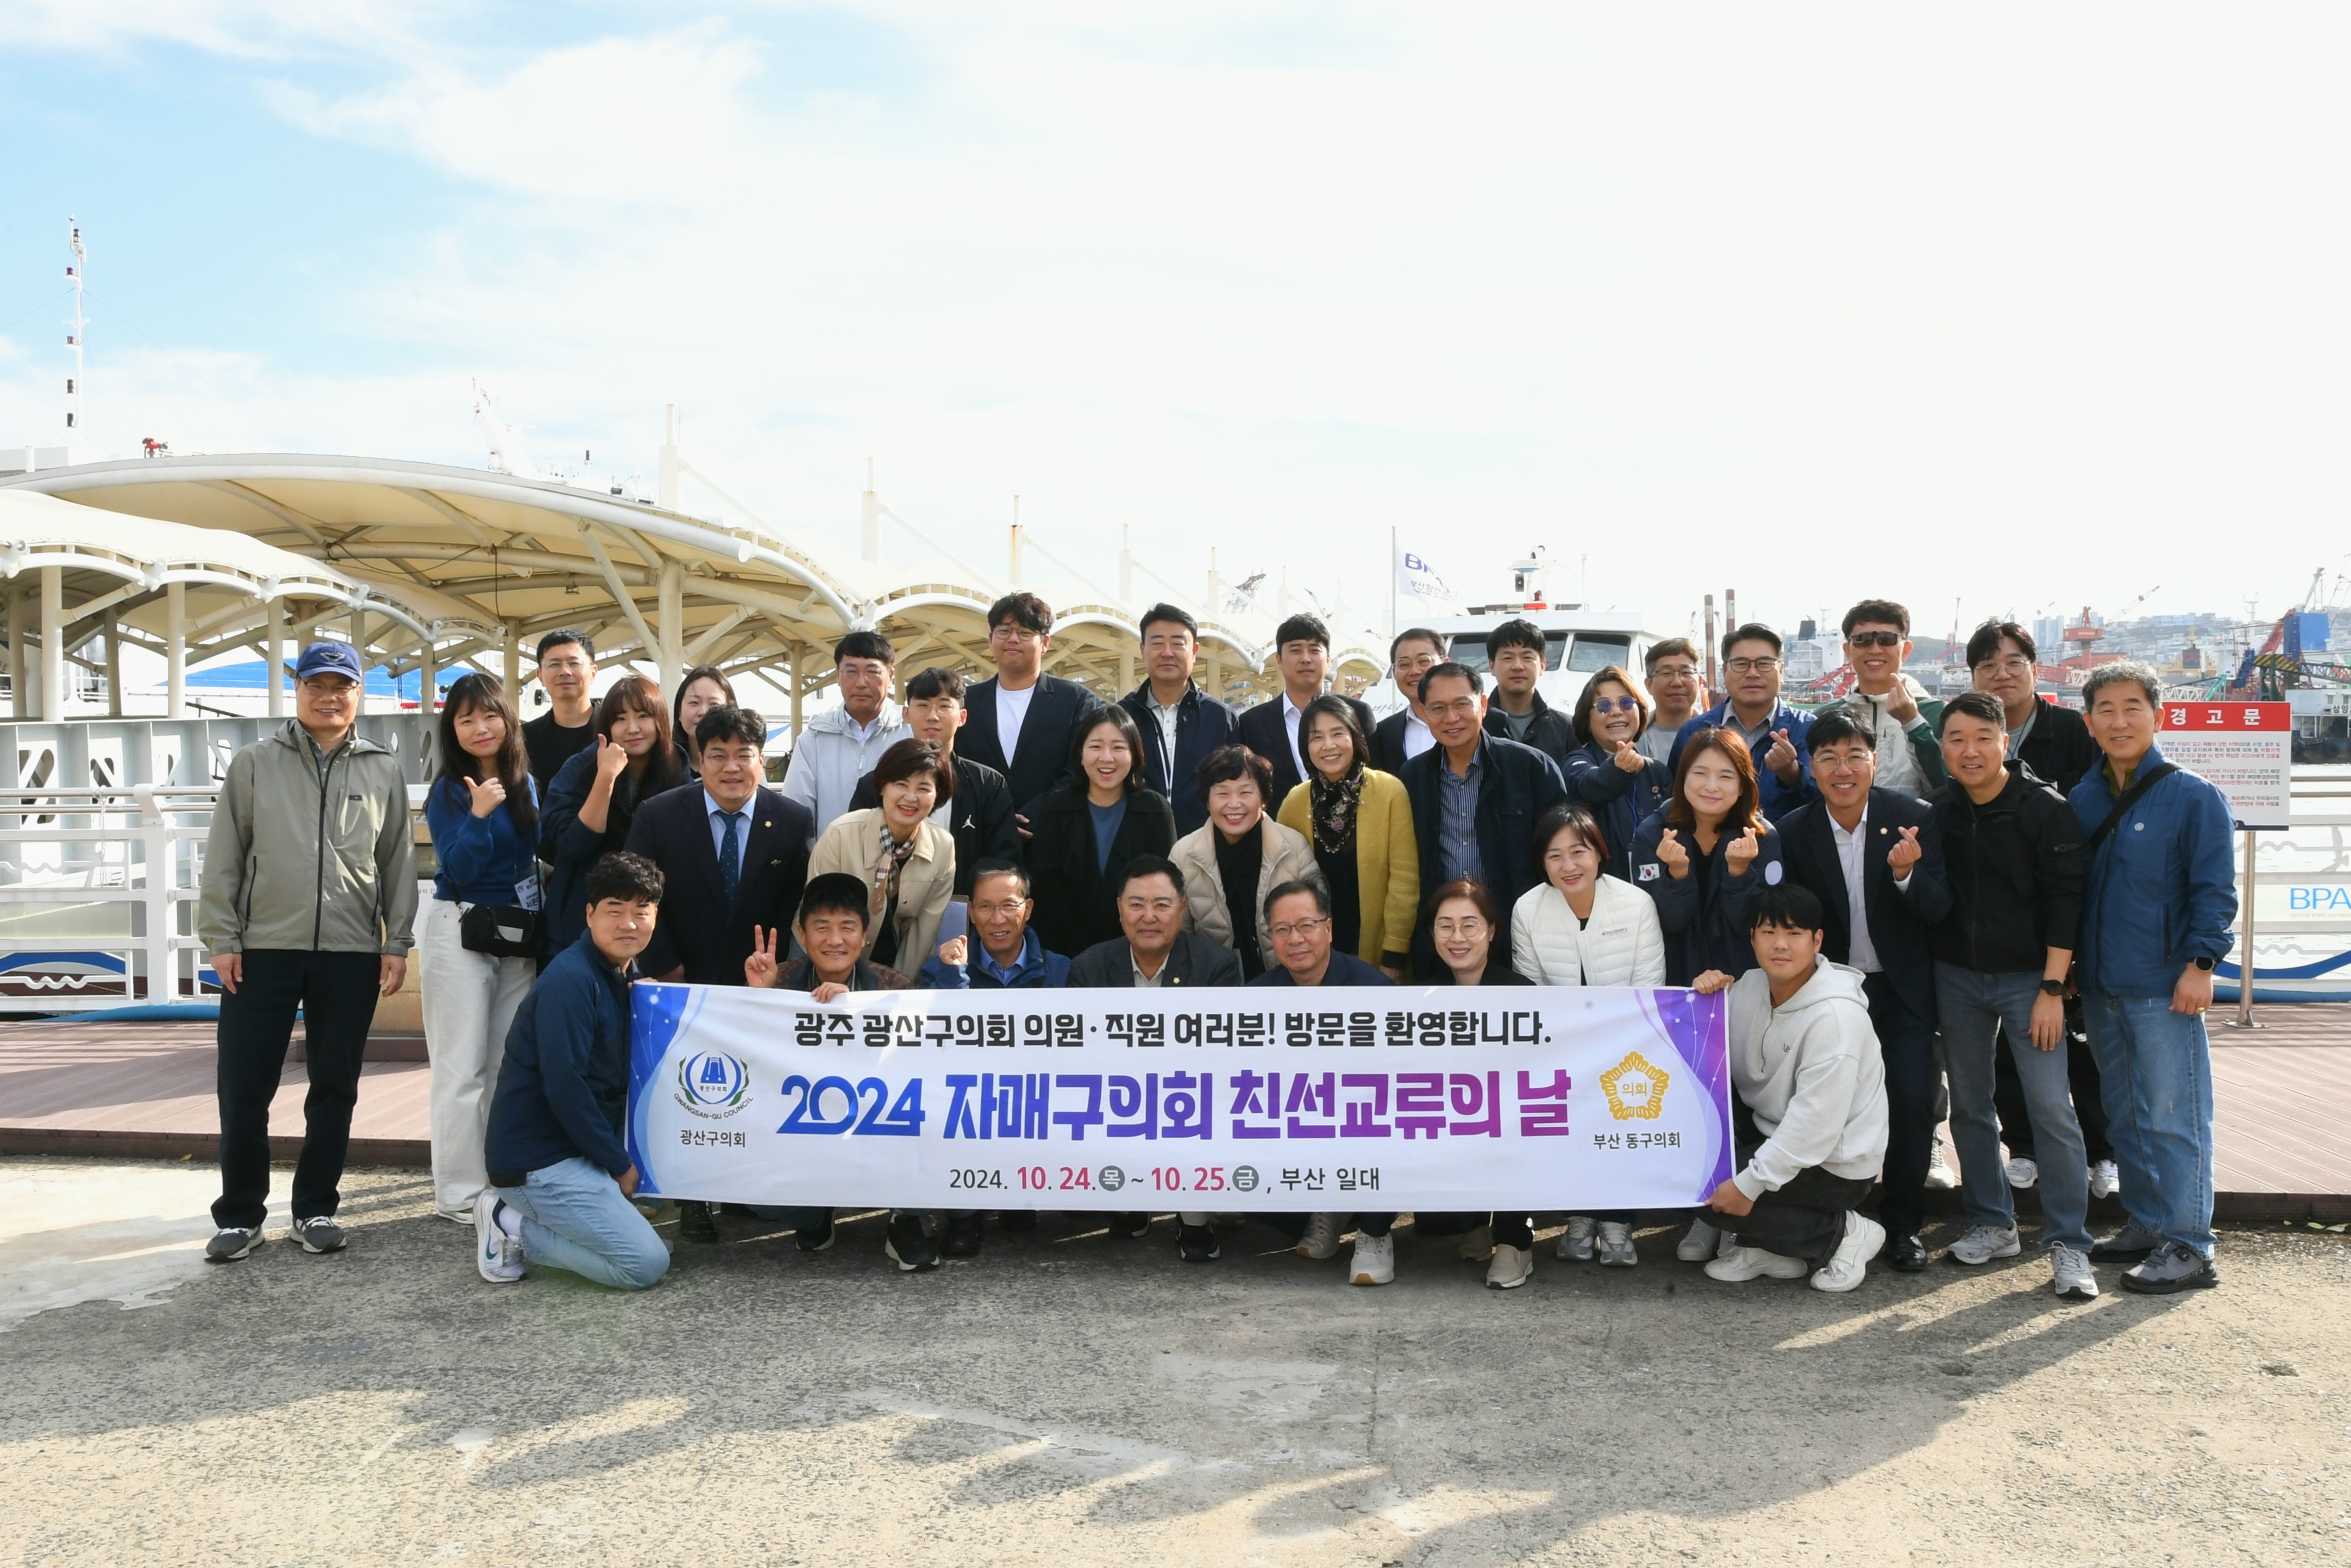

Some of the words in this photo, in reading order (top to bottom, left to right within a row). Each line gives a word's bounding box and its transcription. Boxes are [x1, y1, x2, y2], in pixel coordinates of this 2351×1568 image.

[2170, 708, 2261, 725] 경고문
[2332, 705, 2351, 714] 삼양
[2290, 888, 2351, 910] BPA
[794, 1013, 855, 1046] 광주
[863, 1014, 1015, 1048] 광산구의회
[1175, 1013, 1275, 1047] 여러분!
[1285, 1012, 1377, 1047] 방문을
[1384, 1011, 1551, 1046] 환영합니다.
[1622, 1082, 1647, 1096] 의회
[674, 1093, 722, 1119] GWANGSAN-GU
[724, 1097, 754, 1118] COUNCIL
[775, 1075, 926, 1137] 2024
[943, 1070, 1213, 1141] 자매구의회
[1230, 1069, 1502, 1140] 친선교류의
[1517, 1069, 1572, 1137] 날
[680, 1130, 745, 1148] 광산구의회
[1594, 1133, 1620, 1150] 부산
[1626, 1132, 1680, 1149] 동구의회
[950, 1169, 1008, 1190] 2024.
[1017, 1166, 1052, 1190] 10.
[1151, 1167, 1186, 1191] 10.
[1280, 1168, 1326, 1191] 부산
[1336, 1167, 1380, 1191] 일대
